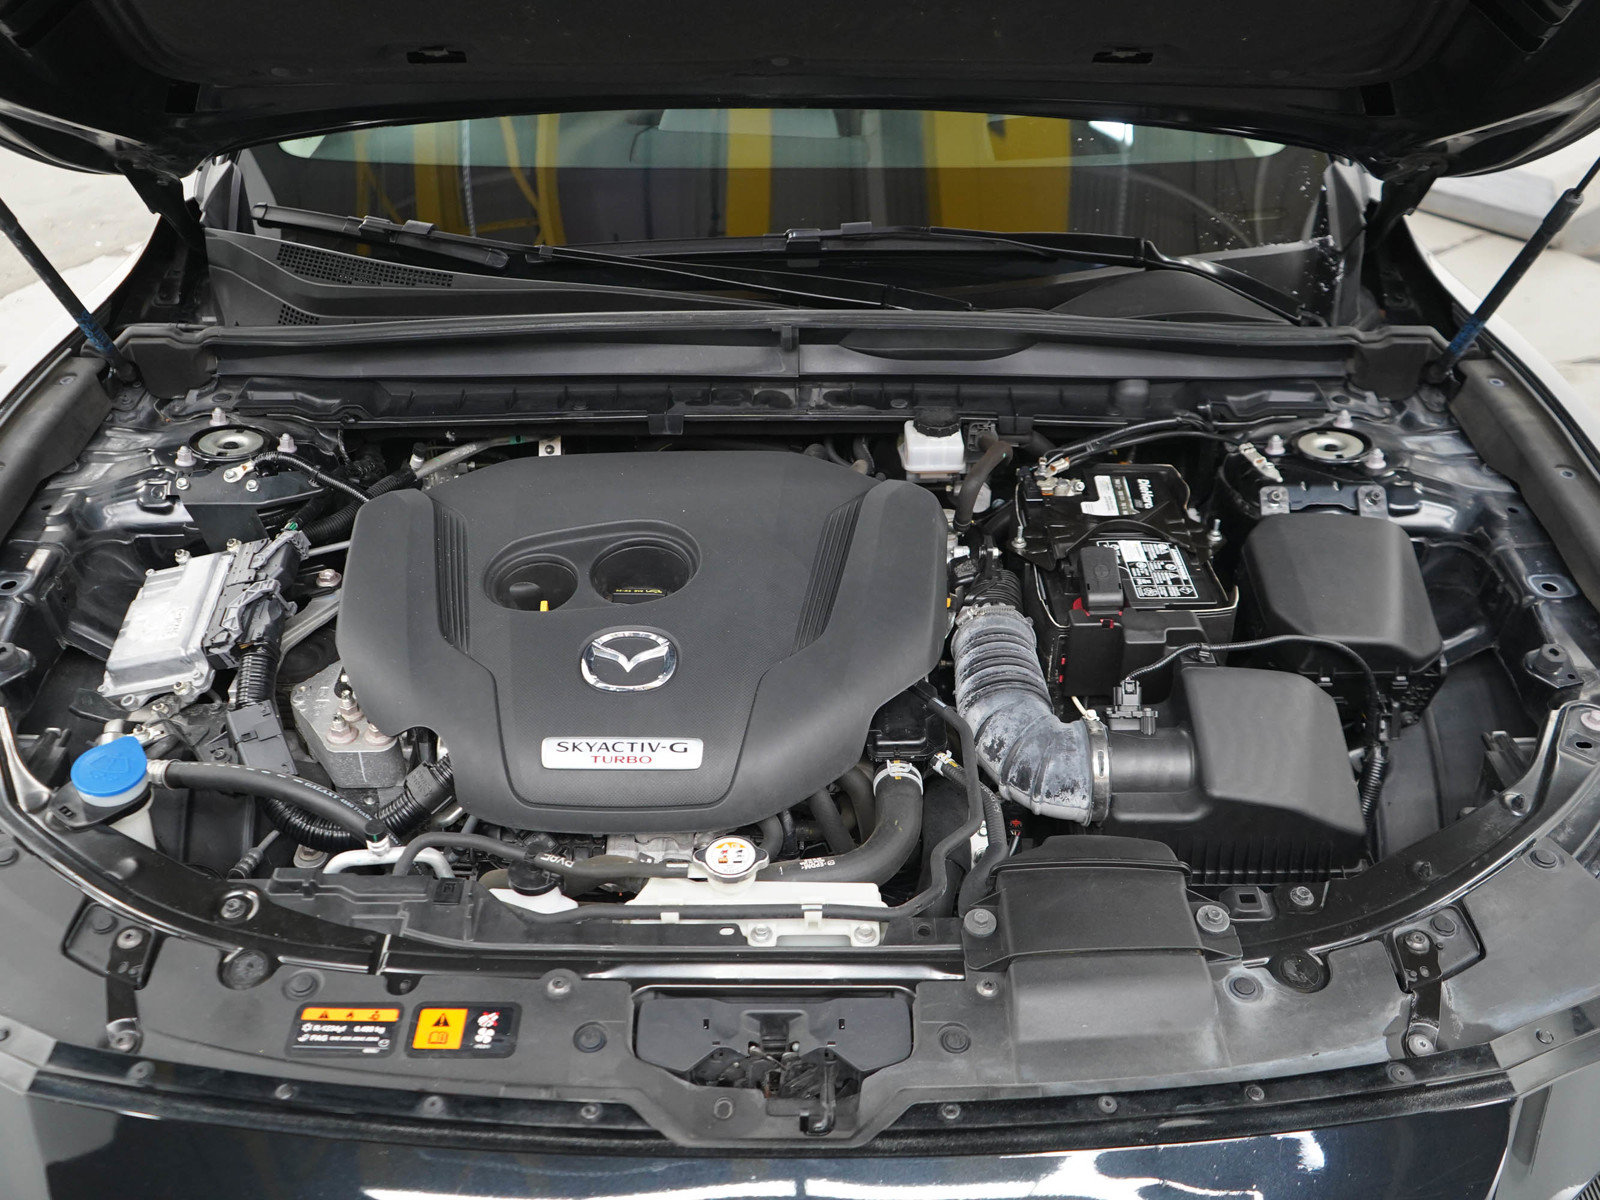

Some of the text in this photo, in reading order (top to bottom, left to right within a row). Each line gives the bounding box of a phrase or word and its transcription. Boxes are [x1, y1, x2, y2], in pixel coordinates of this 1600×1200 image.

[1137, 478, 1154, 509] DieHard
[556, 741, 688, 753] SKYACTIV-G
[591, 755, 652, 764] TURBO
[304, 782, 338, 799] GALAXY
